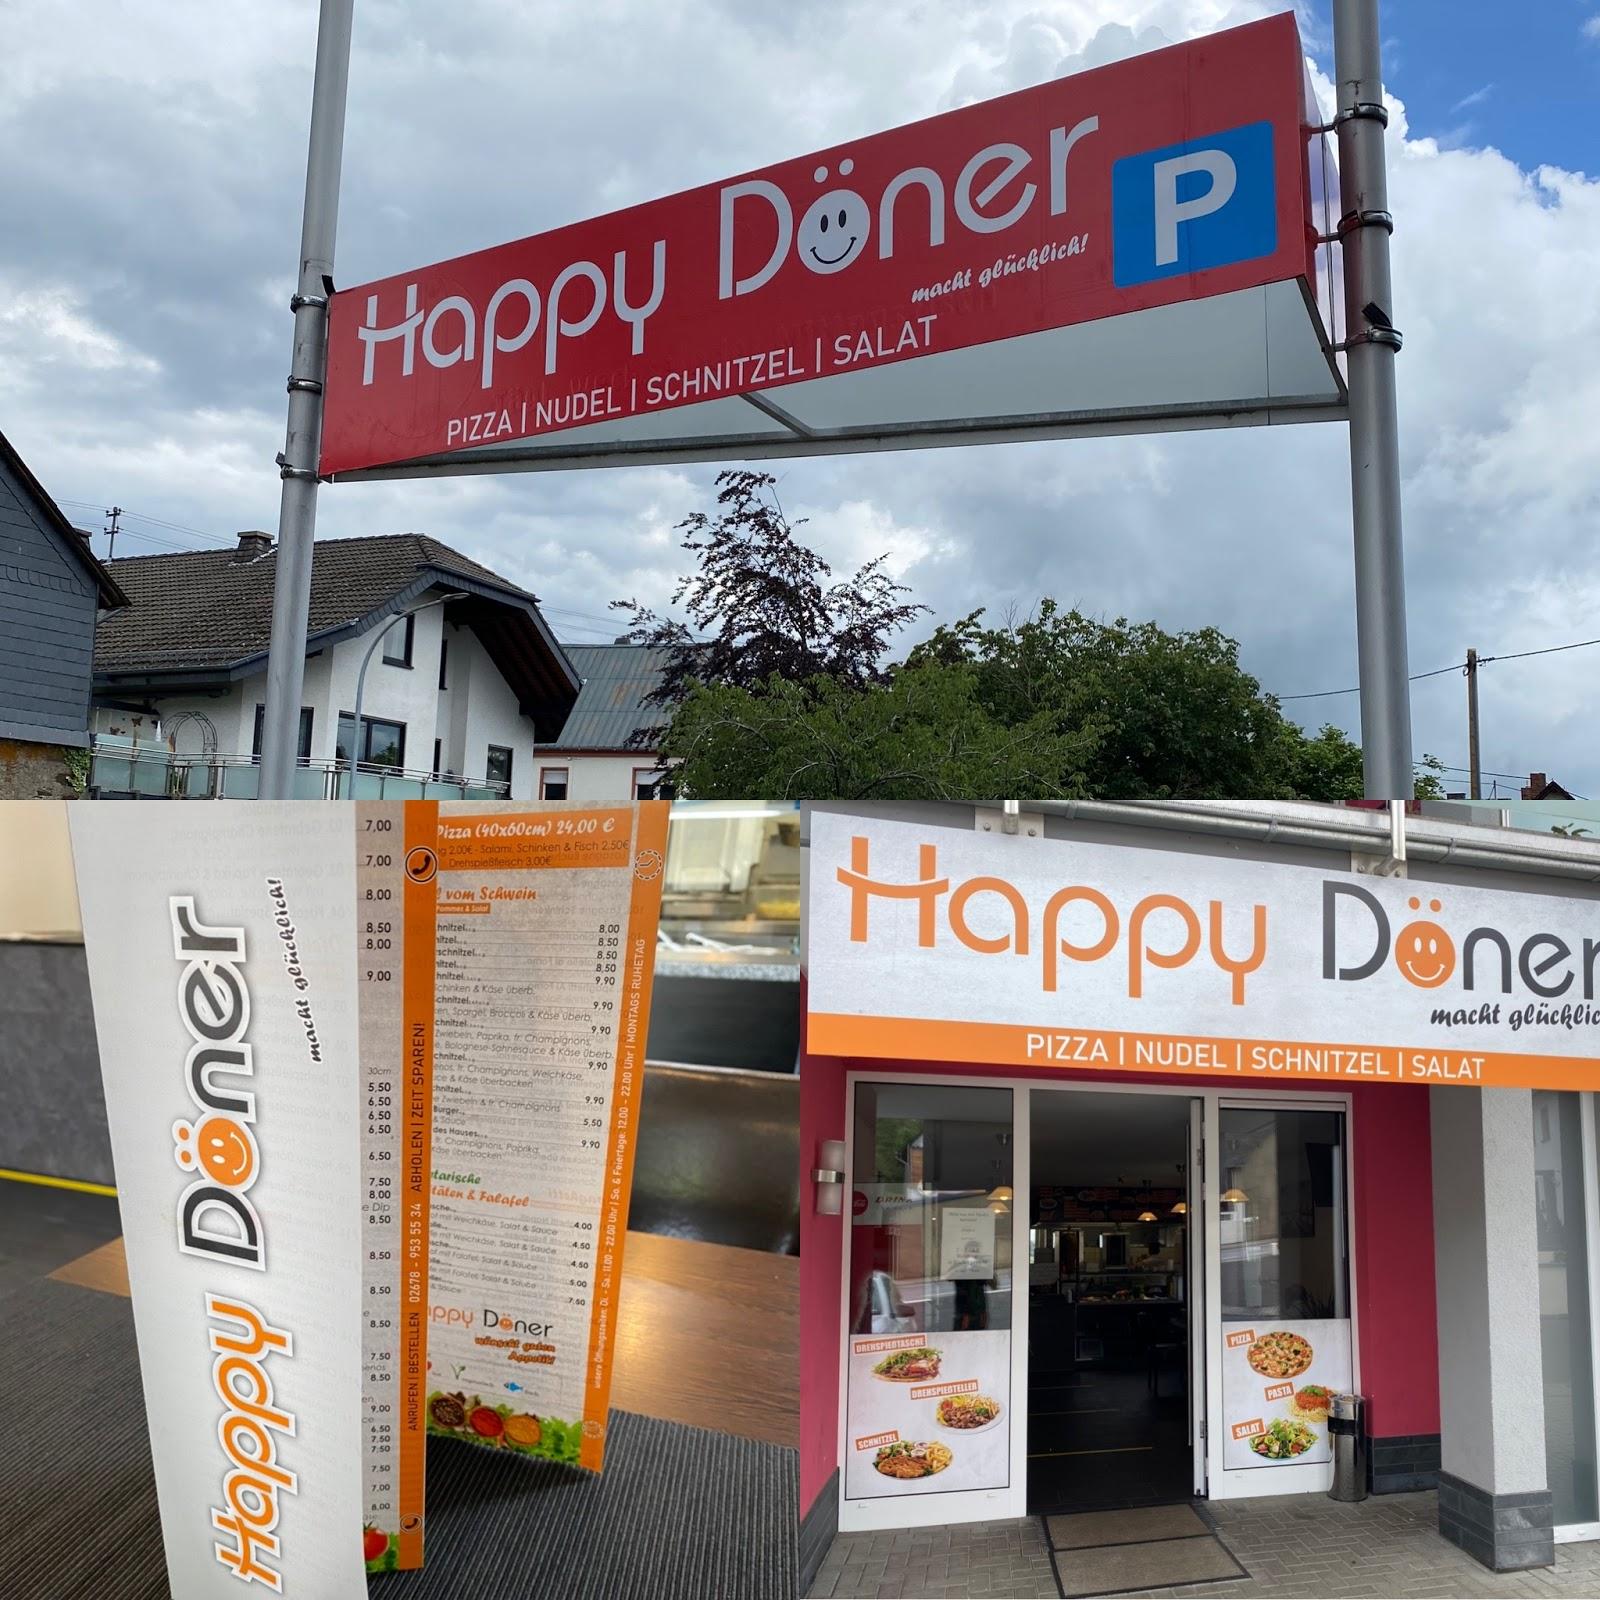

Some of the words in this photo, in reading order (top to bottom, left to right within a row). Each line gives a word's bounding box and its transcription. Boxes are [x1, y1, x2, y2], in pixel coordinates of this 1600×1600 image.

[1153, 149, 1238, 267] P
[357, 239, 667, 390] Happy
[718, 114, 1100, 301] Döner
[910, 271, 973, 303] macht
[978, 233, 1090, 288] glücklich!
[446, 409, 514, 446] PIZZA
[534, 385, 622, 428] NUDEL
[645, 346, 806, 405] SCHNITZEL
[832, 314, 938, 366] SALAT
[365, 820, 392, 833] 7,00
[475, 820, 551, 838] (40x60cm)
[555, 818, 598, 838] 24,00
[602, 816, 616, 834] €
[516, 842, 561, 856] Schinken
[574, 840, 599, 853] Fisch
[365, 854, 392, 867] 7,00
[365, 889, 392, 901] 8,00
[446, 890, 475, 901] vom
[479, 885, 538, 901] Schwein
[366, 922, 392, 935] 8,50
[836, 835, 1268, 1007] Happy
[265, 876, 312, 992] glücklich!
[366, 938, 392, 951] 8,00
[631, 938, 647, 990] RUHETAG
[366, 970, 392, 983] 9,00
[437, 983, 471, 994] chinken
[481, 983, 504, 994] Käse
[625, 991, 642, 1043] MONTAGS
[1429, 1003, 1501, 1026] macht
[299, 997, 323, 1065] macht
[411, 1022, 426, 1086] SPAREN!
[623, 1051, 635, 1071] Uhr
[1026, 1033, 1109, 1063] PIZZA
[1135, 1039, 1228, 1069] NUDEL
[1250, 1046, 1391, 1077] SCHNITZEL
[1411, 1054, 1486, 1080] SALAT
[367, 1067, 392, 1076] 30cm
[176, 904, 260, 1264] Döner
[367, 1082, 391, 1092] 5,50
[367, 1096, 391, 1107] 6,50
[411, 1088, 425, 1119] ZEIT
[367, 1110, 391, 1121] 6,50
[368, 1124, 391, 1135] 6,50
[368, 1151, 391, 1162] 6,50
[409, 1129, 424, 1193] ABHOLEN
[369, 1177, 391, 1187] 7,50
[369, 1190, 391, 1200] 8,00
[478, 1190, 530, 1208] Falafel
[371, 1201, 391, 1213] Dip
[409, 1202, 422, 1217] 34
[369, 1214, 391, 1224] 8,50
[409, 1219, 422, 1235] 55
[369, 1251, 391, 1260] 8,50
[409, 1237, 421, 1259] 953
[369, 1286, 391, 1295] 8,50
[408, 1270, 421, 1303] 02678
[369, 1320, 391, 1329] 8,50
[429, 1305, 474, 1330] ppy
[483, 1308, 555, 1339] Döner
[407, 1311, 421, 1375] BESTELLEN
[1230, 1332, 1252, 1346] PIZZA
[370, 1353, 391, 1362] 7,50
[370, 1374, 391, 1383] 8,50
[1266, 1385, 1293, 1400] PASTA
[407, 1382, 420, 1432] ANRUFEN
[1235, 1421, 1261, 1438] SALAT
[210, 1298, 294, 1586] Happy
[857, 1433, 898, 1450] SCHNITZEL
